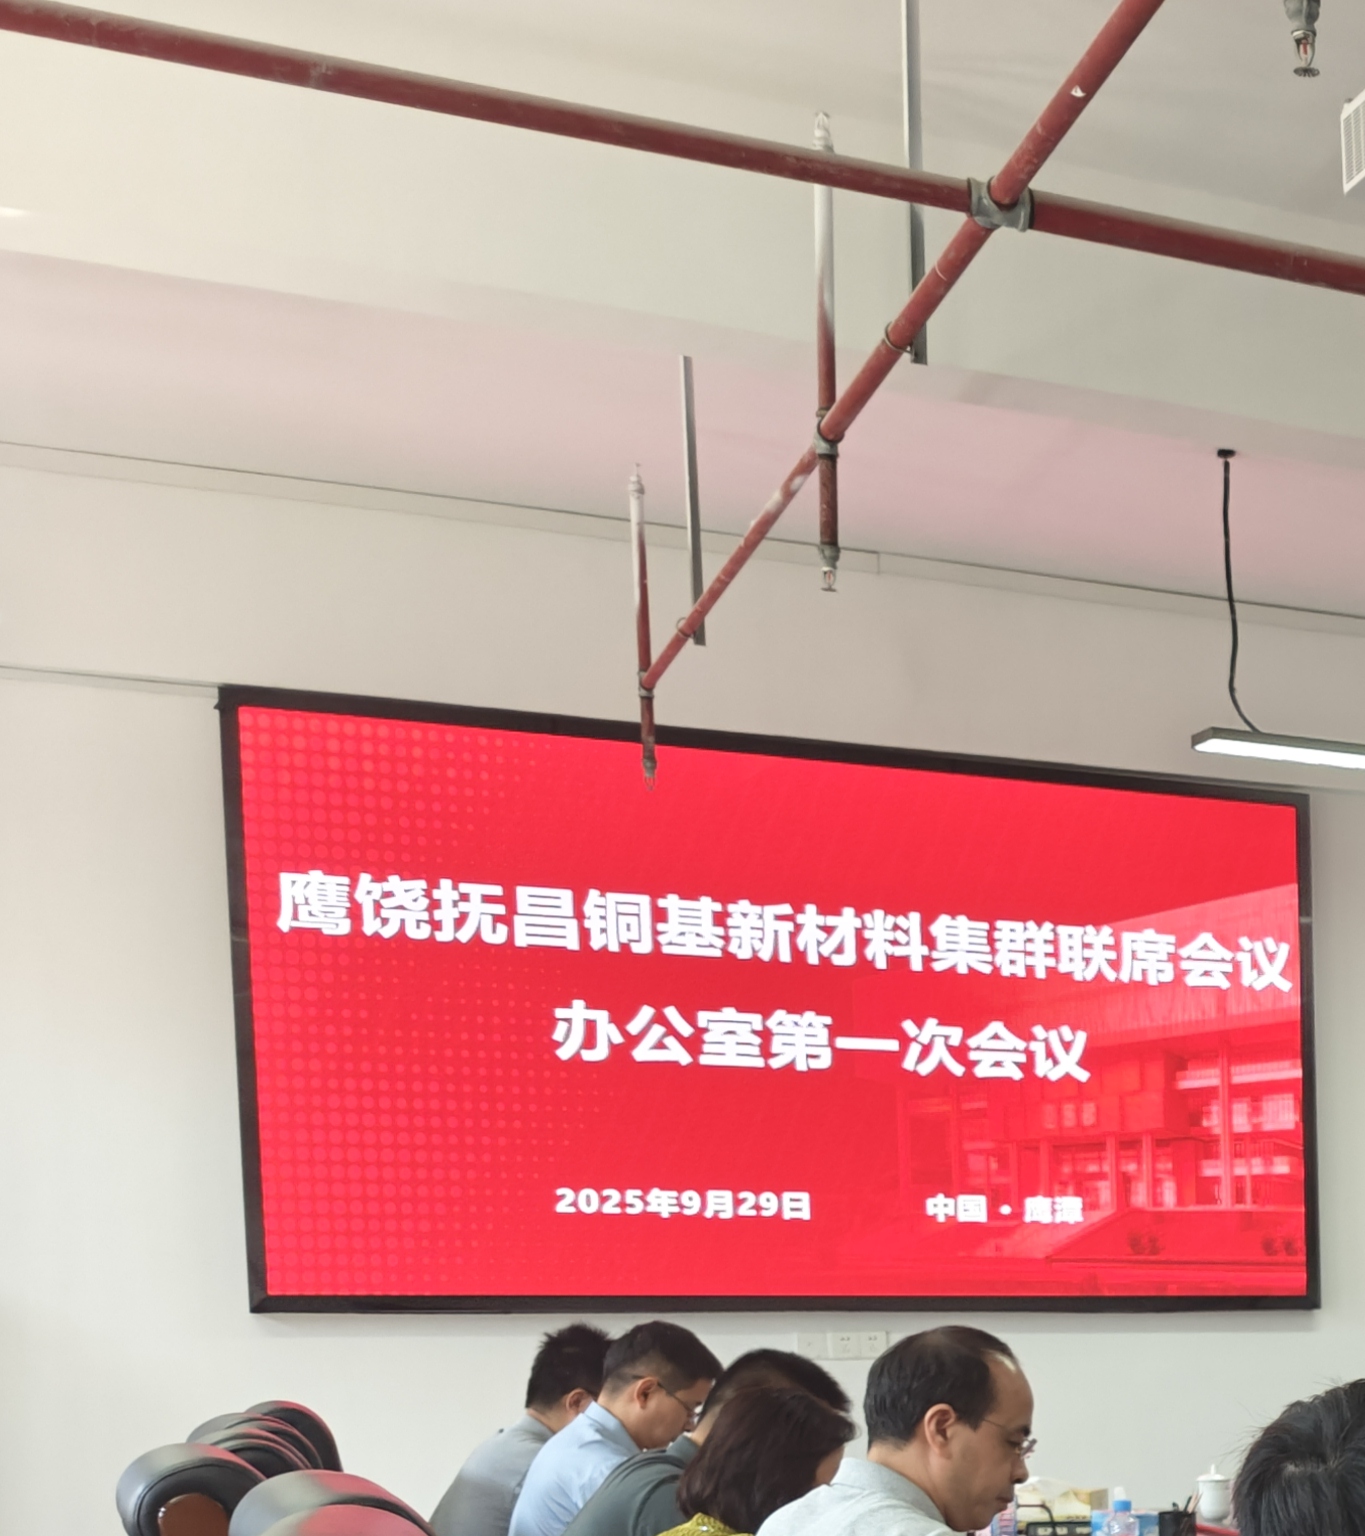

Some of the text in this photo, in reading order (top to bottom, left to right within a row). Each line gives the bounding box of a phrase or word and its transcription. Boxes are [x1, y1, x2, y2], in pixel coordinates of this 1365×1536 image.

[275, 869, 1293, 994] 鹰饶抚昌铜基新材料集群联席会议
[551, 999, 1091, 1083] 办公室第一次会议
[554, 1187, 812, 1221] 2025年9月29日
